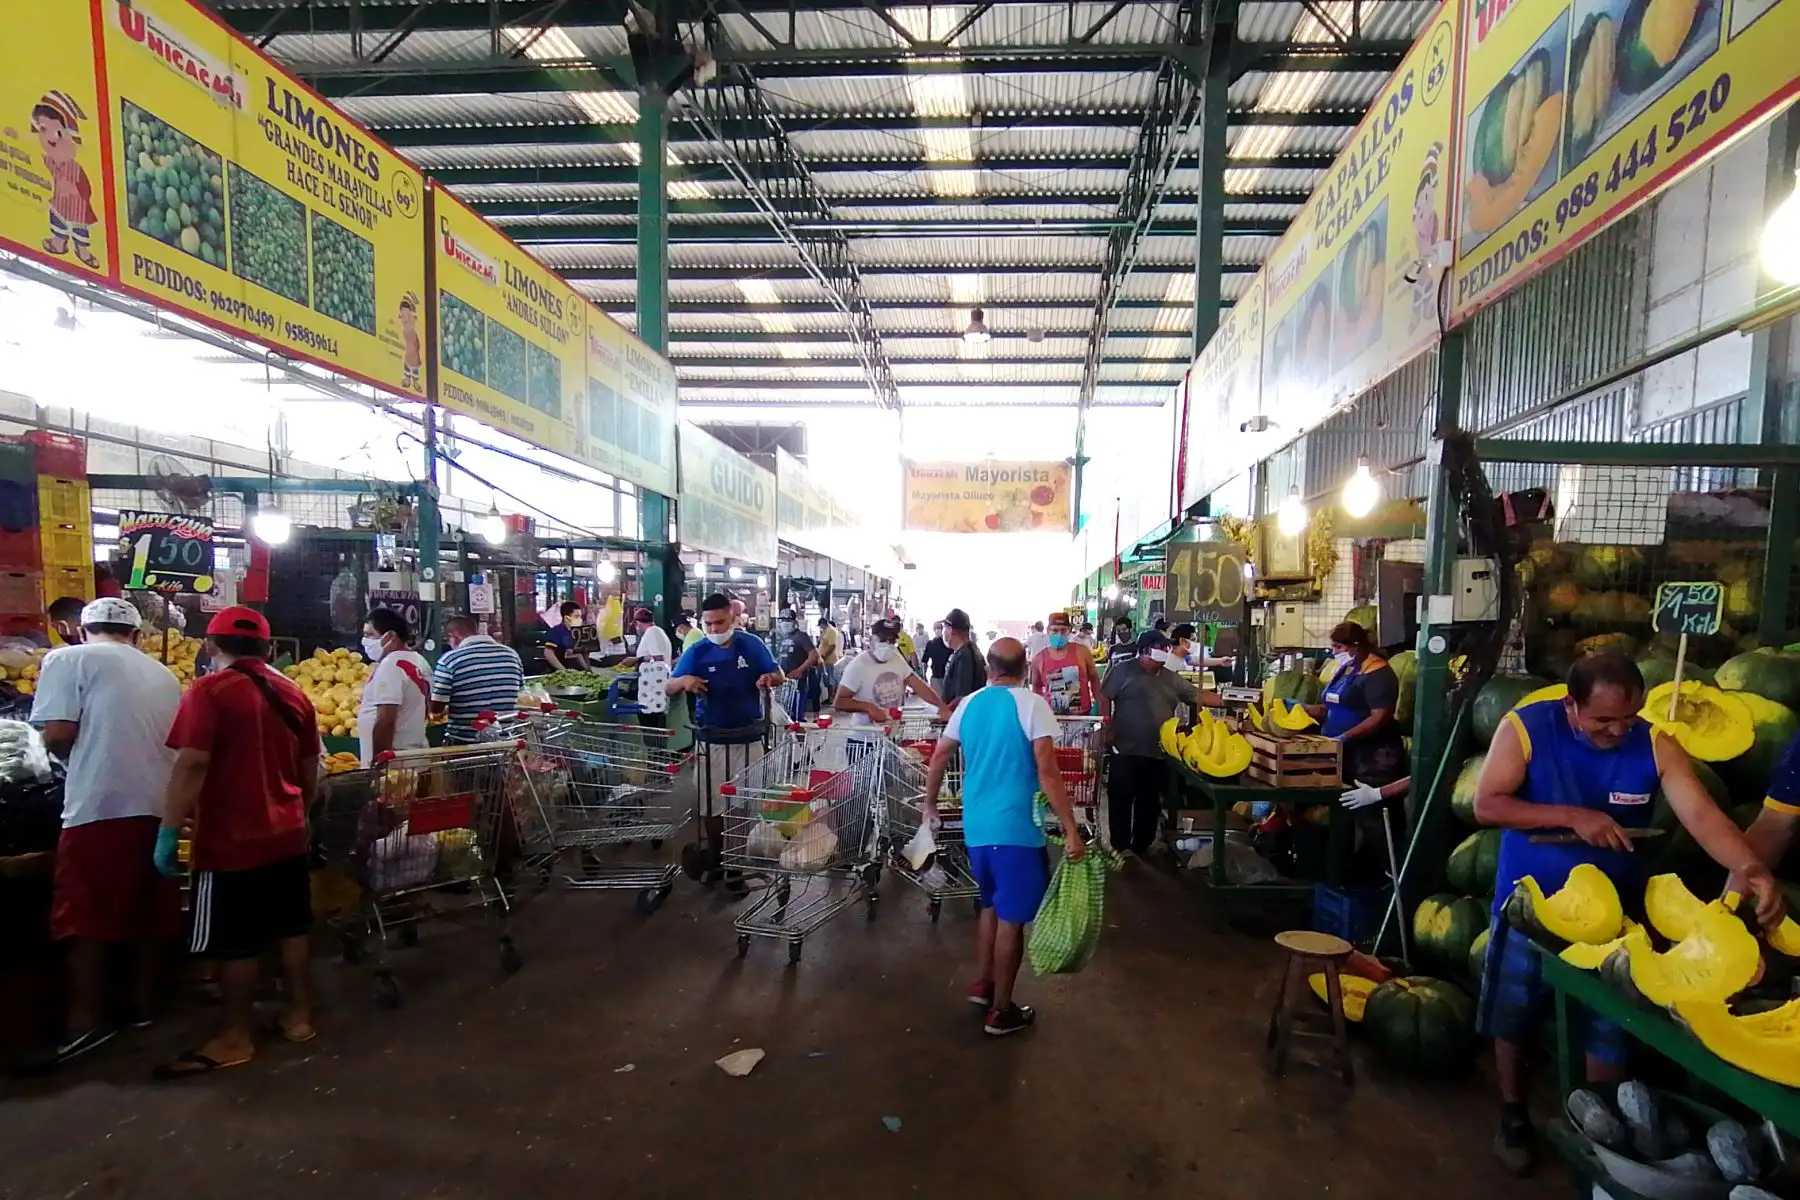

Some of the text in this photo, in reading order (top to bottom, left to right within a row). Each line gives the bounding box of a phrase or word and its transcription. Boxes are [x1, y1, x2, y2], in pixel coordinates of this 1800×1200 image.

[265, 76, 379, 182] LIMONES
[1314, 68, 1414, 231] ZAPALLOS
[286, 159, 320, 198] HACE
[322, 180, 336, 208] EL
[327, 159, 392, 218] MARAVILLAS
[1316, 127, 1404, 251] "CHALE"
[1457, 218, 1549, 307] PEDIDOS:
[1556, 171, 1599, 234] 988
[1605, 123, 1657, 192] 444
[1666, 72, 1731, 153] 520
[133, 253, 207, 304] PEDIDOS:
[210, 290, 275, 331] 962970499
[285, 320, 338, 357] 958839614
[504, 259, 563, 320] LIMONES
[625, 343, 661, 383] LIMONES
[710, 456, 764, 512] GUIDO
[912, 490, 960, 501] Mayorista
[965, 465, 1050, 486] Mayorista
[1142, 575, 1160, 590] MAIZ
